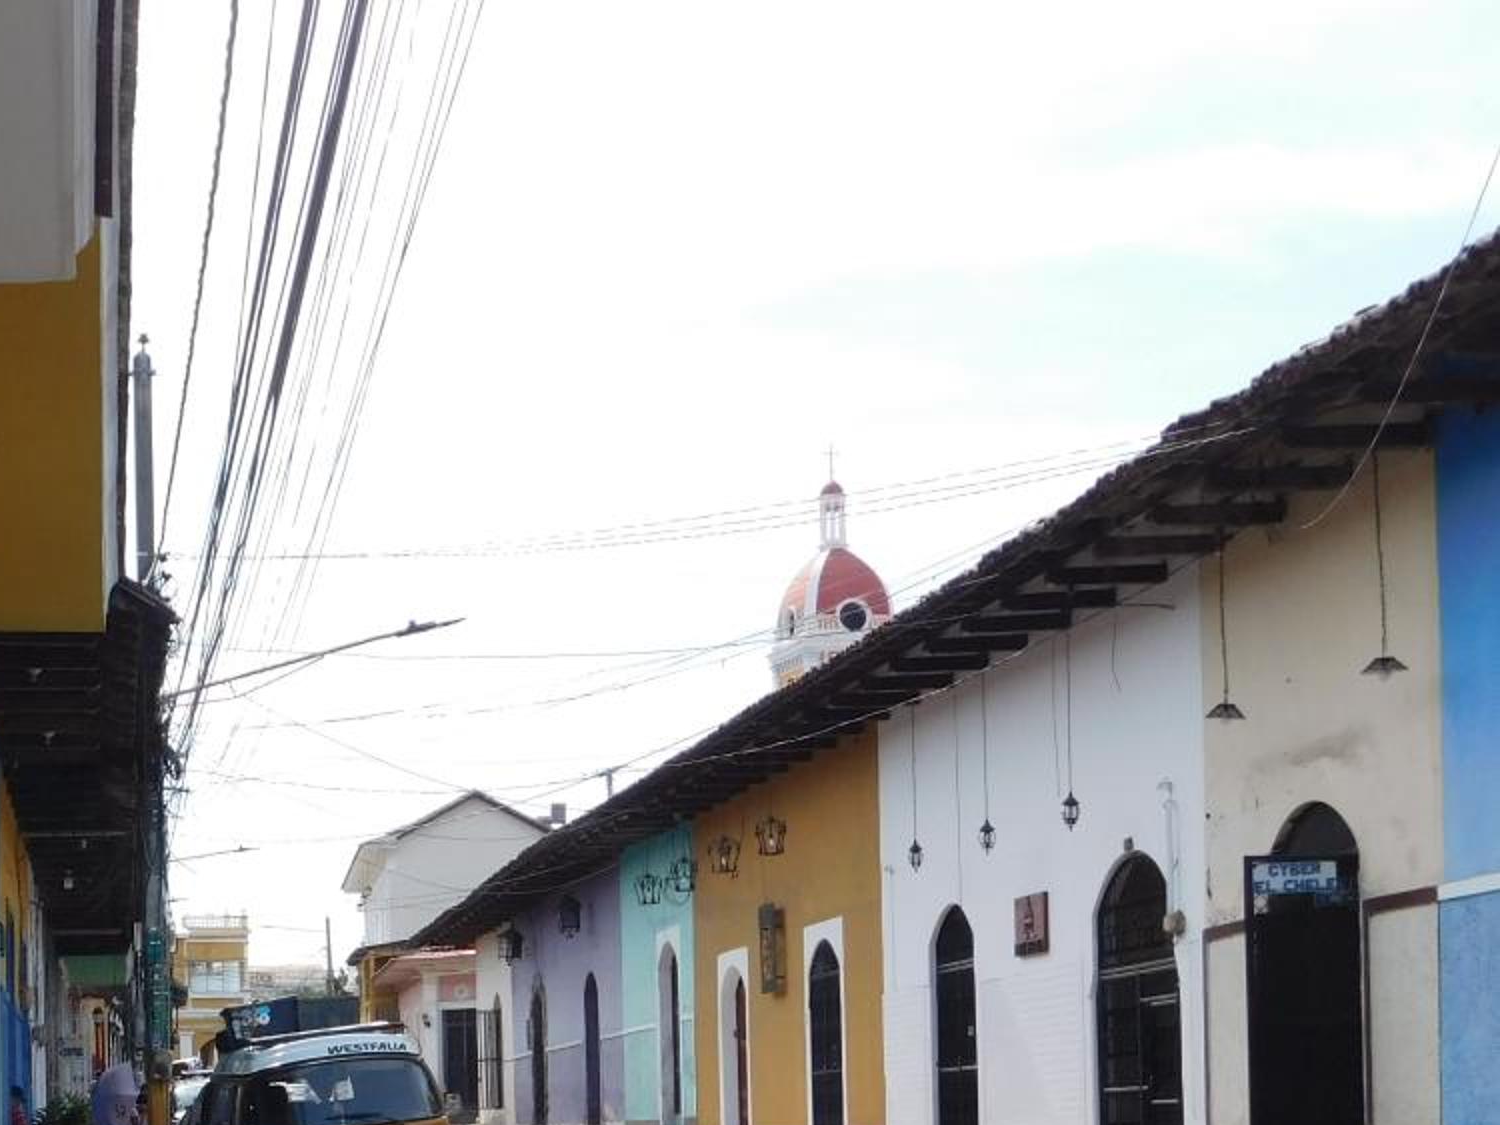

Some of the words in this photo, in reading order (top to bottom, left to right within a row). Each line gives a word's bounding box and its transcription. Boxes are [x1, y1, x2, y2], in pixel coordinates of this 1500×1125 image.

[1268, 864, 1321, 877] CYBER
[1253, 880, 1275, 894] EL
[327, 1042, 407, 1055] WESTFALIA
